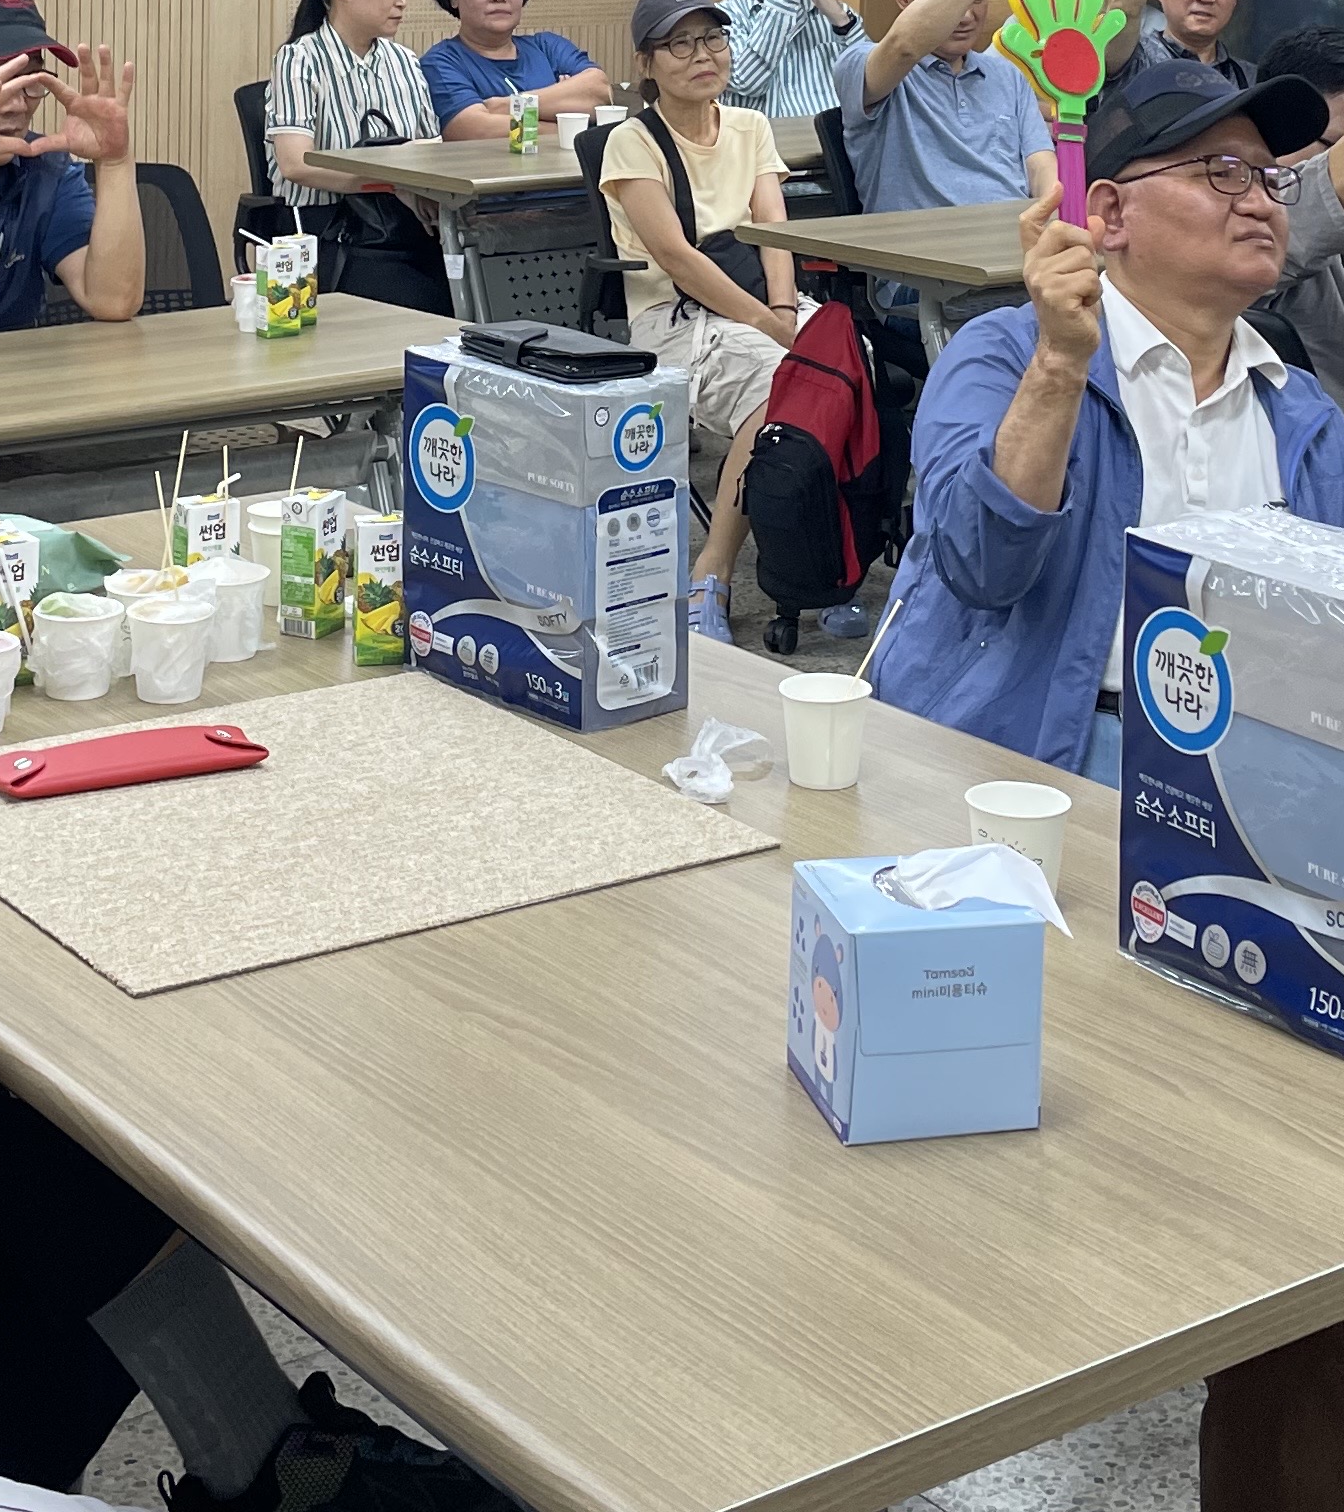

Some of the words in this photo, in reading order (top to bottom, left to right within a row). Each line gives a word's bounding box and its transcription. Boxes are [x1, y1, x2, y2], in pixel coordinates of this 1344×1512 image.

[624, 424, 655, 441] 깨끗한
[423, 436, 463, 466] 깨끗한
[628, 441, 650, 455] 나라
[429, 461, 456, 487] 나라
[199, 522, 226, 542] 썬업
[370, 543, 400, 562] 썬업
[548, 591, 574, 607] SOFY
[537, 611, 568, 628] SOFTY
[1155, 648, 1214, 693] 깨끗한
[1164, 683, 1203, 721] 나라
[1310, 710, 1342, 732] PURE
[1307, 861, 1340, 886] PURE
